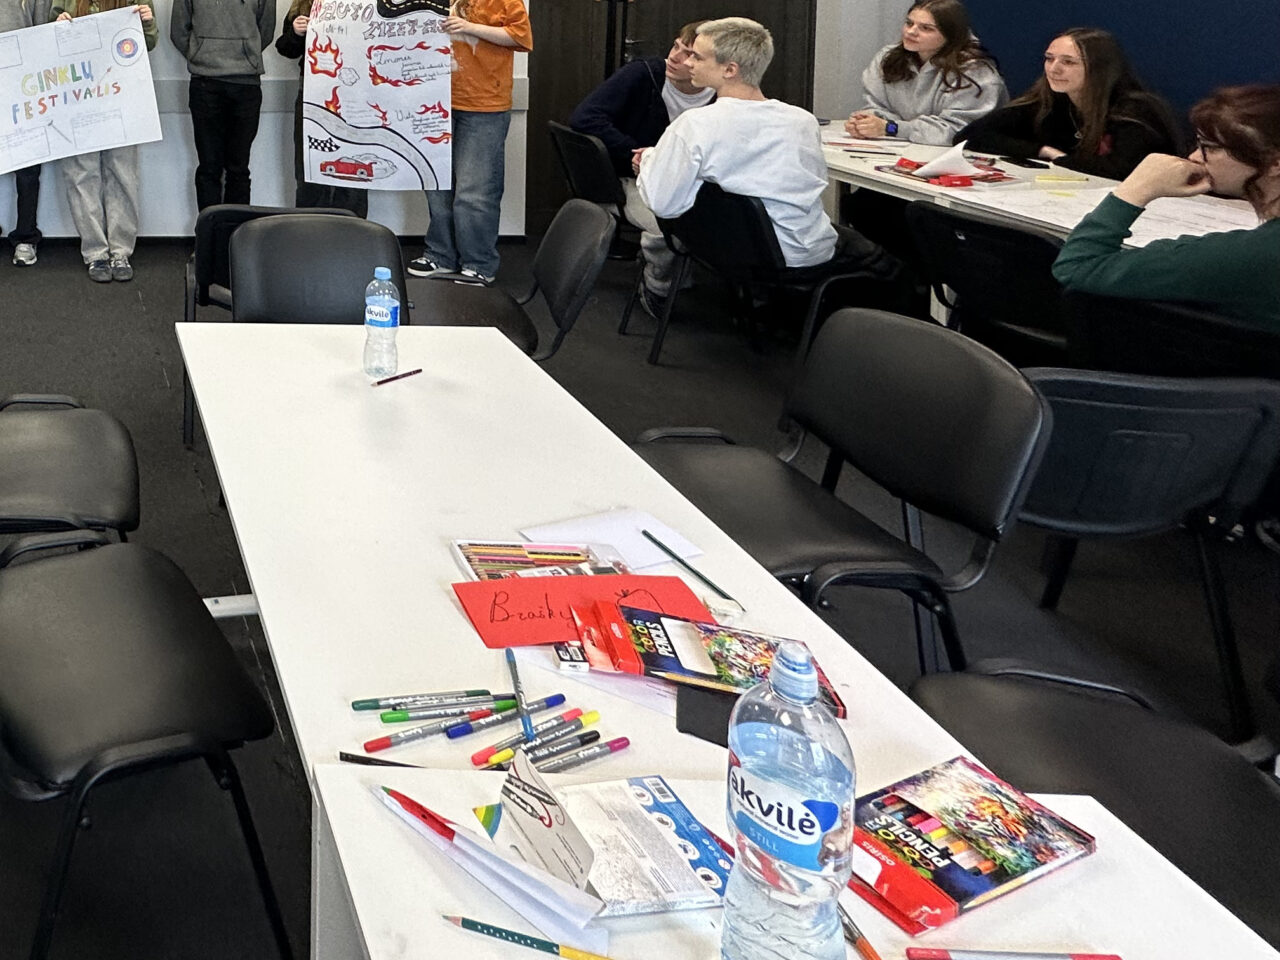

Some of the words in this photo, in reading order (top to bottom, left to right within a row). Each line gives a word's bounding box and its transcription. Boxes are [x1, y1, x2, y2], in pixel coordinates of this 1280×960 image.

[12, 82, 121, 124] FESTIVALIS
[647, 621, 675, 658] PENCILS
[731, 771, 817, 836] akvilė
[748, 826, 779, 854] STILL
[862, 841, 896, 866] OSIRIS
[874, 814, 951, 868] PENCILS
